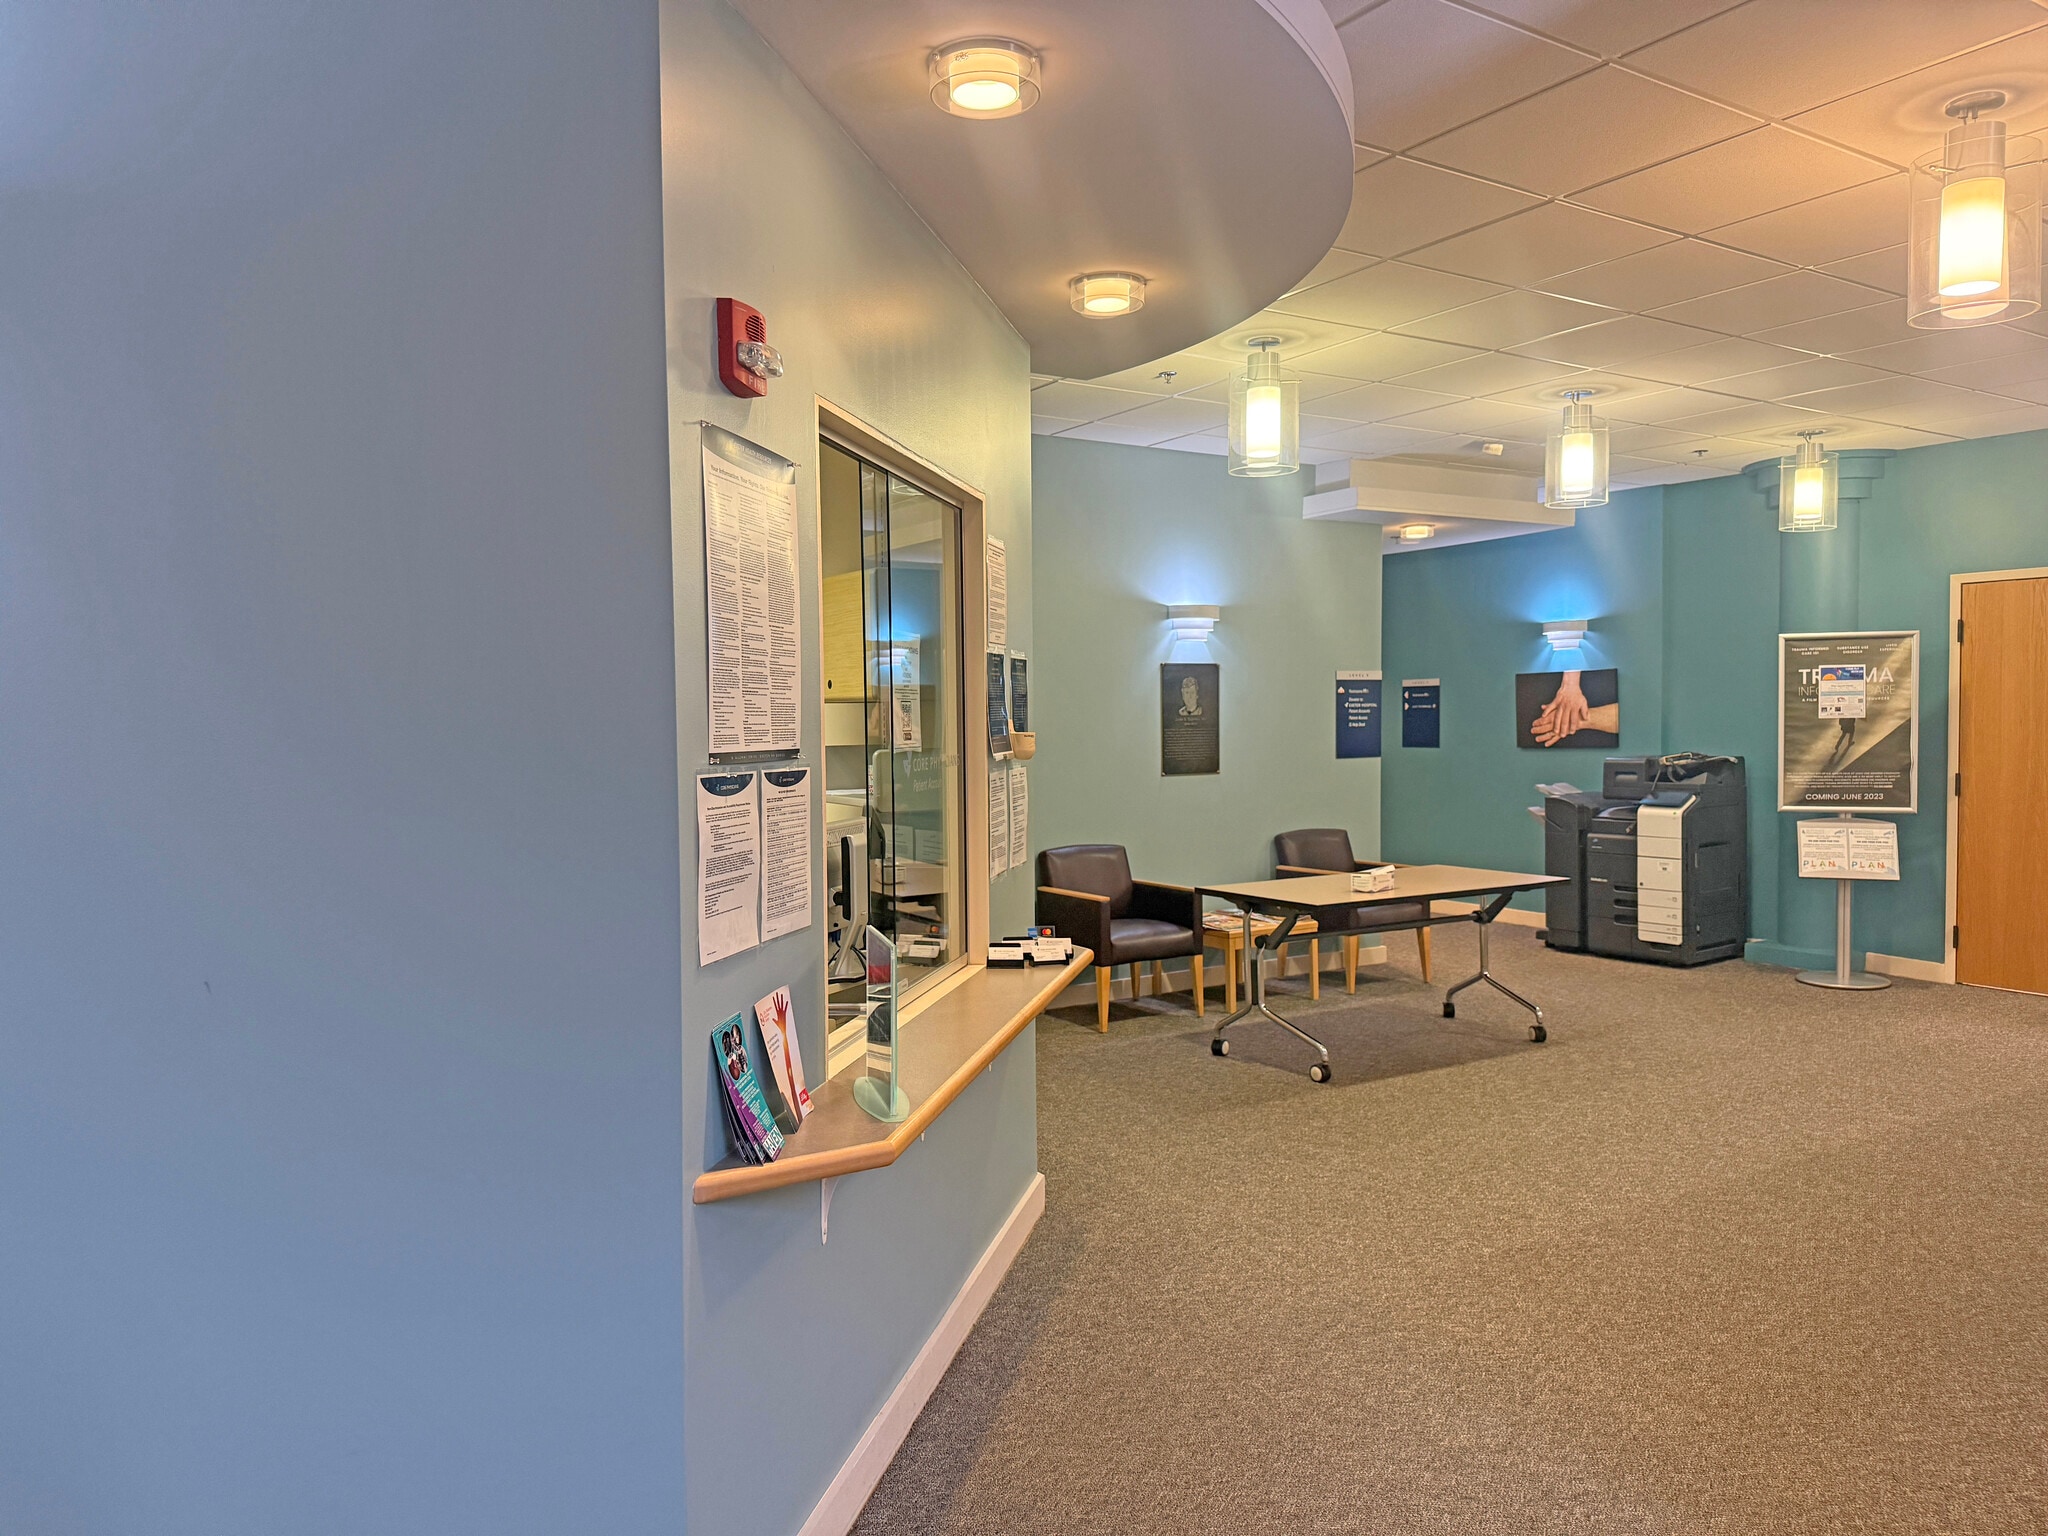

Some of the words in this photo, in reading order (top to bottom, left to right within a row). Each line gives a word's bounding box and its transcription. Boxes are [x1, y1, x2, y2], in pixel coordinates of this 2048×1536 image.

[748, 374, 766, 393] FIRE
[1798, 667, 1894, 685] TRMA
[913, 757, 929, 772] CORE
[1805, 793, 1840, 801] COMING
[1863, 792, 1884, 800] 2023
[1803, 860, 1836, 868] PLAN
[1852, 861, 1886, 869] PLAN
[763, 1125, 783, 1157] HAVEN
